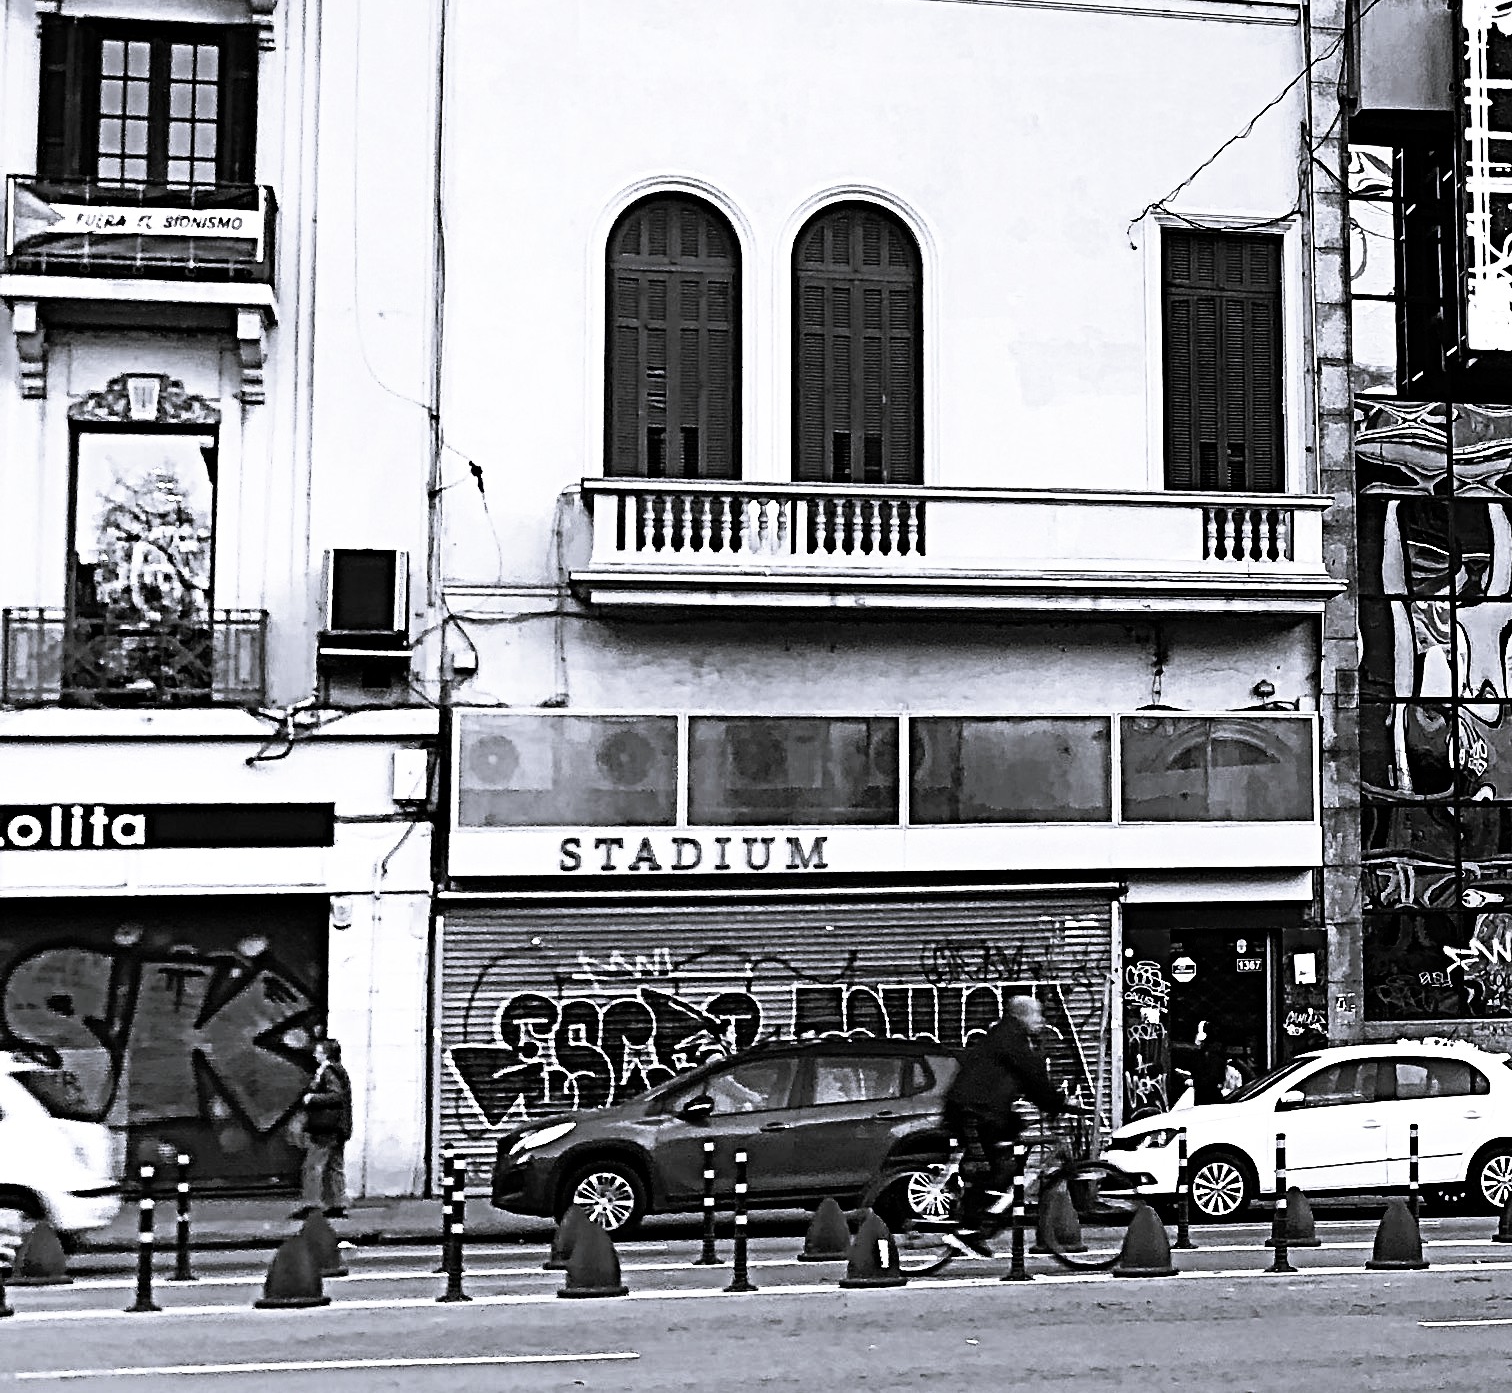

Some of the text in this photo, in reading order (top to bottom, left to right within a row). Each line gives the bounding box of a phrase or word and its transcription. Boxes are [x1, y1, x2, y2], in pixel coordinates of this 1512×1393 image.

[163, 215, 243, 230] SIONISMO
[0, 805, 146, 847] olita
[559, 836, 829, 872] STADIUM
